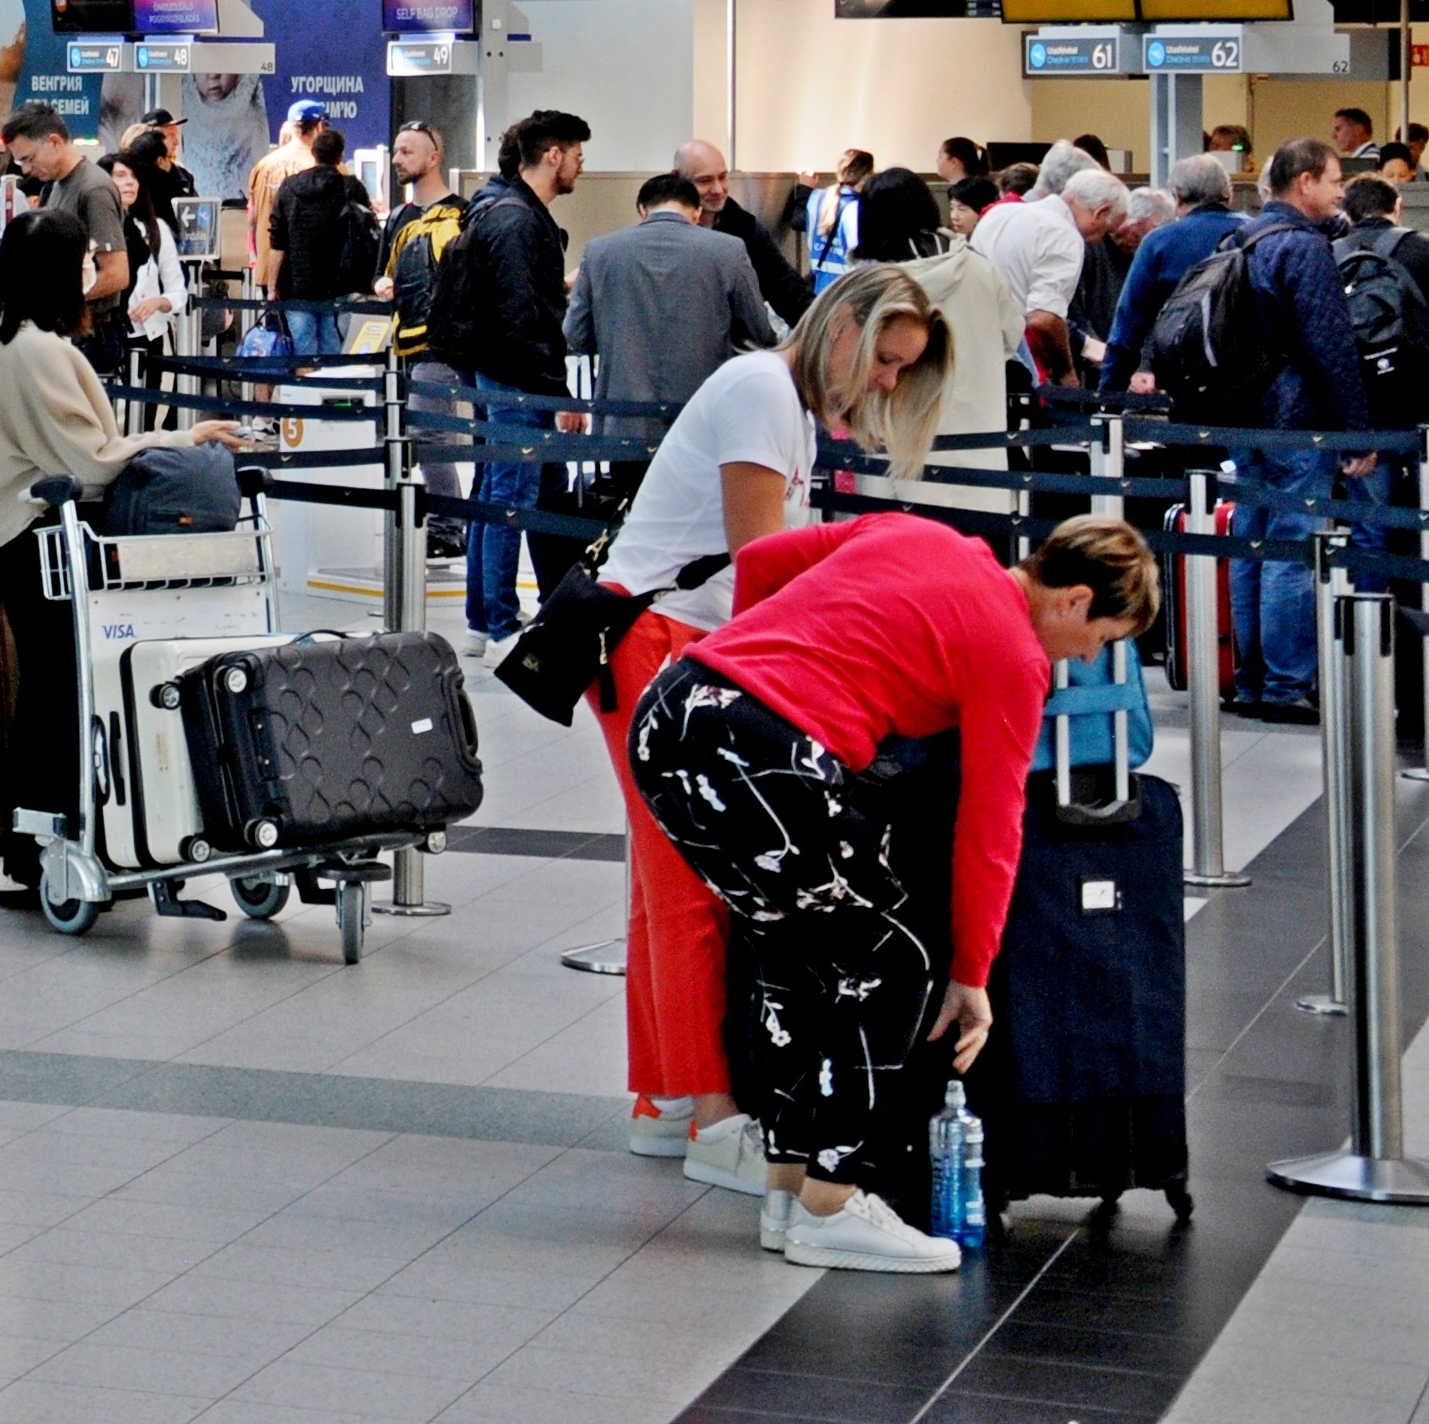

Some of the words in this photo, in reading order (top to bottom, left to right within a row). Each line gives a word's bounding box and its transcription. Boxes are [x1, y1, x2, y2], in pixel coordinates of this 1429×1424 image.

[396, 8, 416, 20] SELF
[417, 8, 435, 19] BAG
[436, 7, 459, 18] DROP
[106, 48, 120, 67] 47
[174, 48, 188, 66] 48
[433, 46, 449, 65] 49
[1092, 43, 1113, 69] 61
[1211, 41, 1239, 68] 62
[261, 62, 273, 72] 48
[1332, 59, 1349, 73] 62
[31, 76, 83, 92] ВЕНГРИЯ
[291, 76, 364, 96] УГОРЩИНА
[57, 98, 89, 115] СЕМЕЙ
[288, 417, 297, 438] 5
[103, 624, 135, 639] VISA
